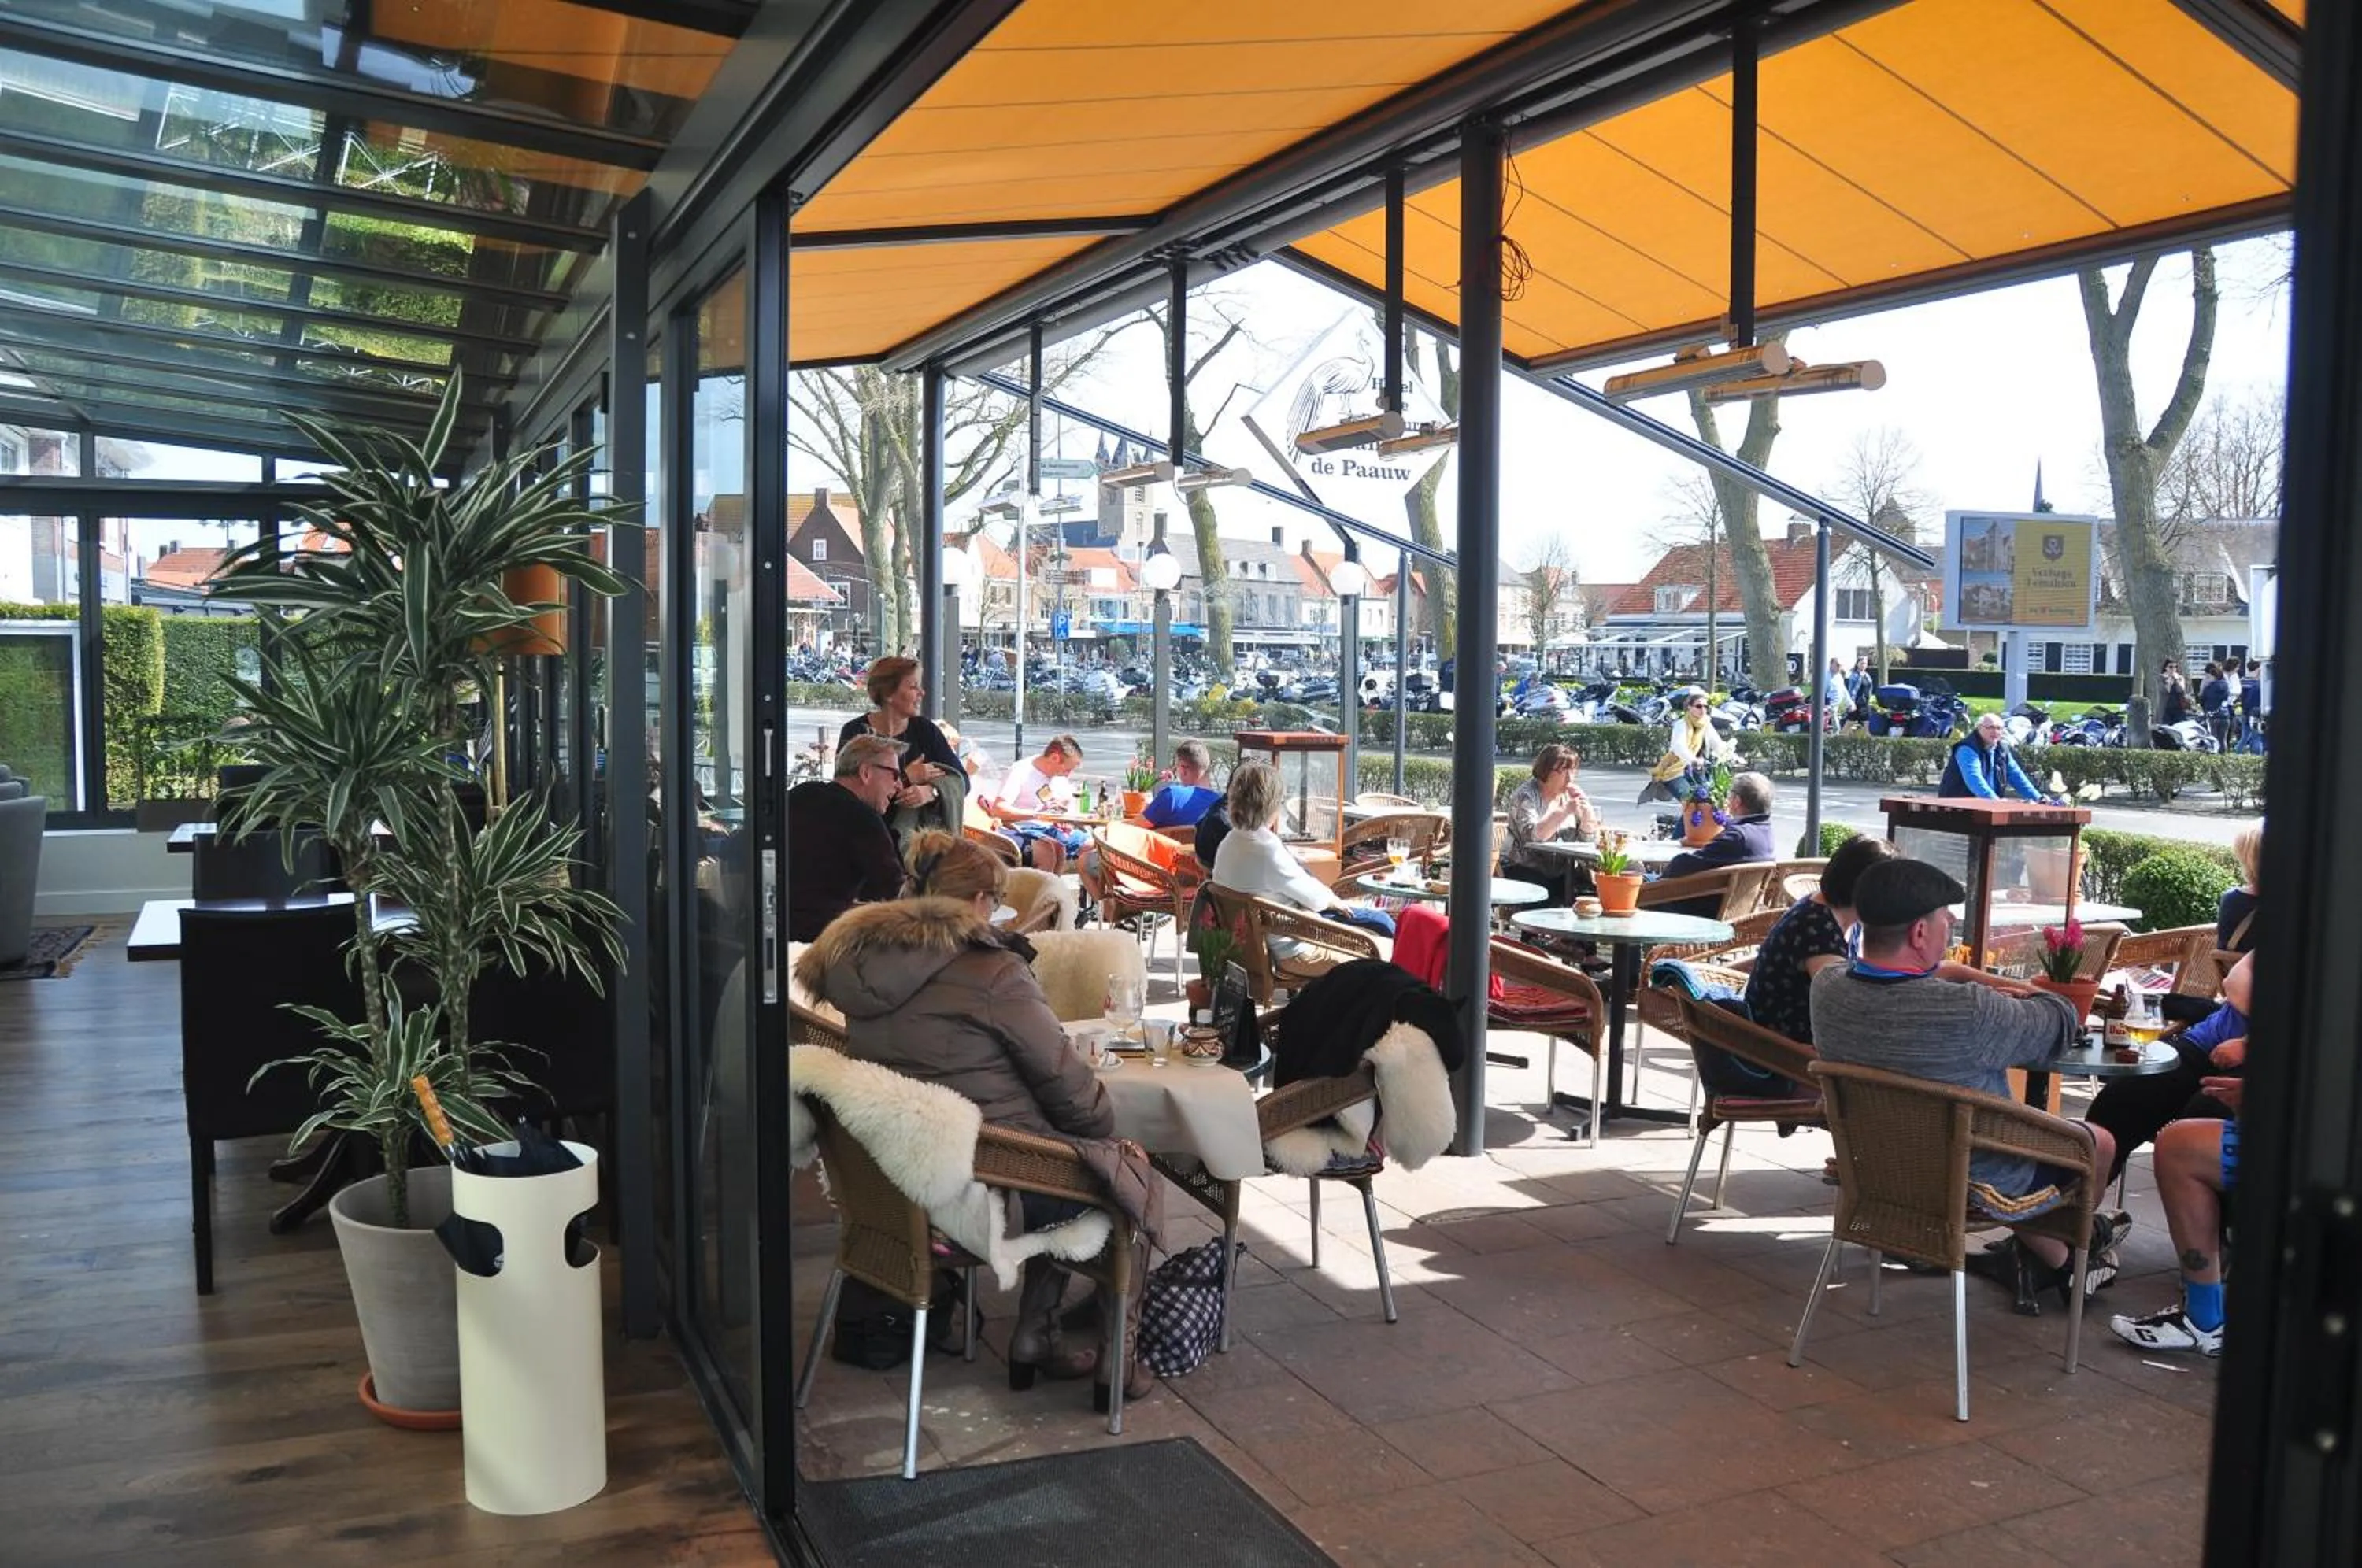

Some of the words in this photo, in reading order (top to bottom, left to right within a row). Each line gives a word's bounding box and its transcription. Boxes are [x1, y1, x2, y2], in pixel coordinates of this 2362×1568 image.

[1372, 377, 1413, 394] Hel
[1311, 457, 1335, 475] de
[1342, 459, 1412, 480] Paauw
